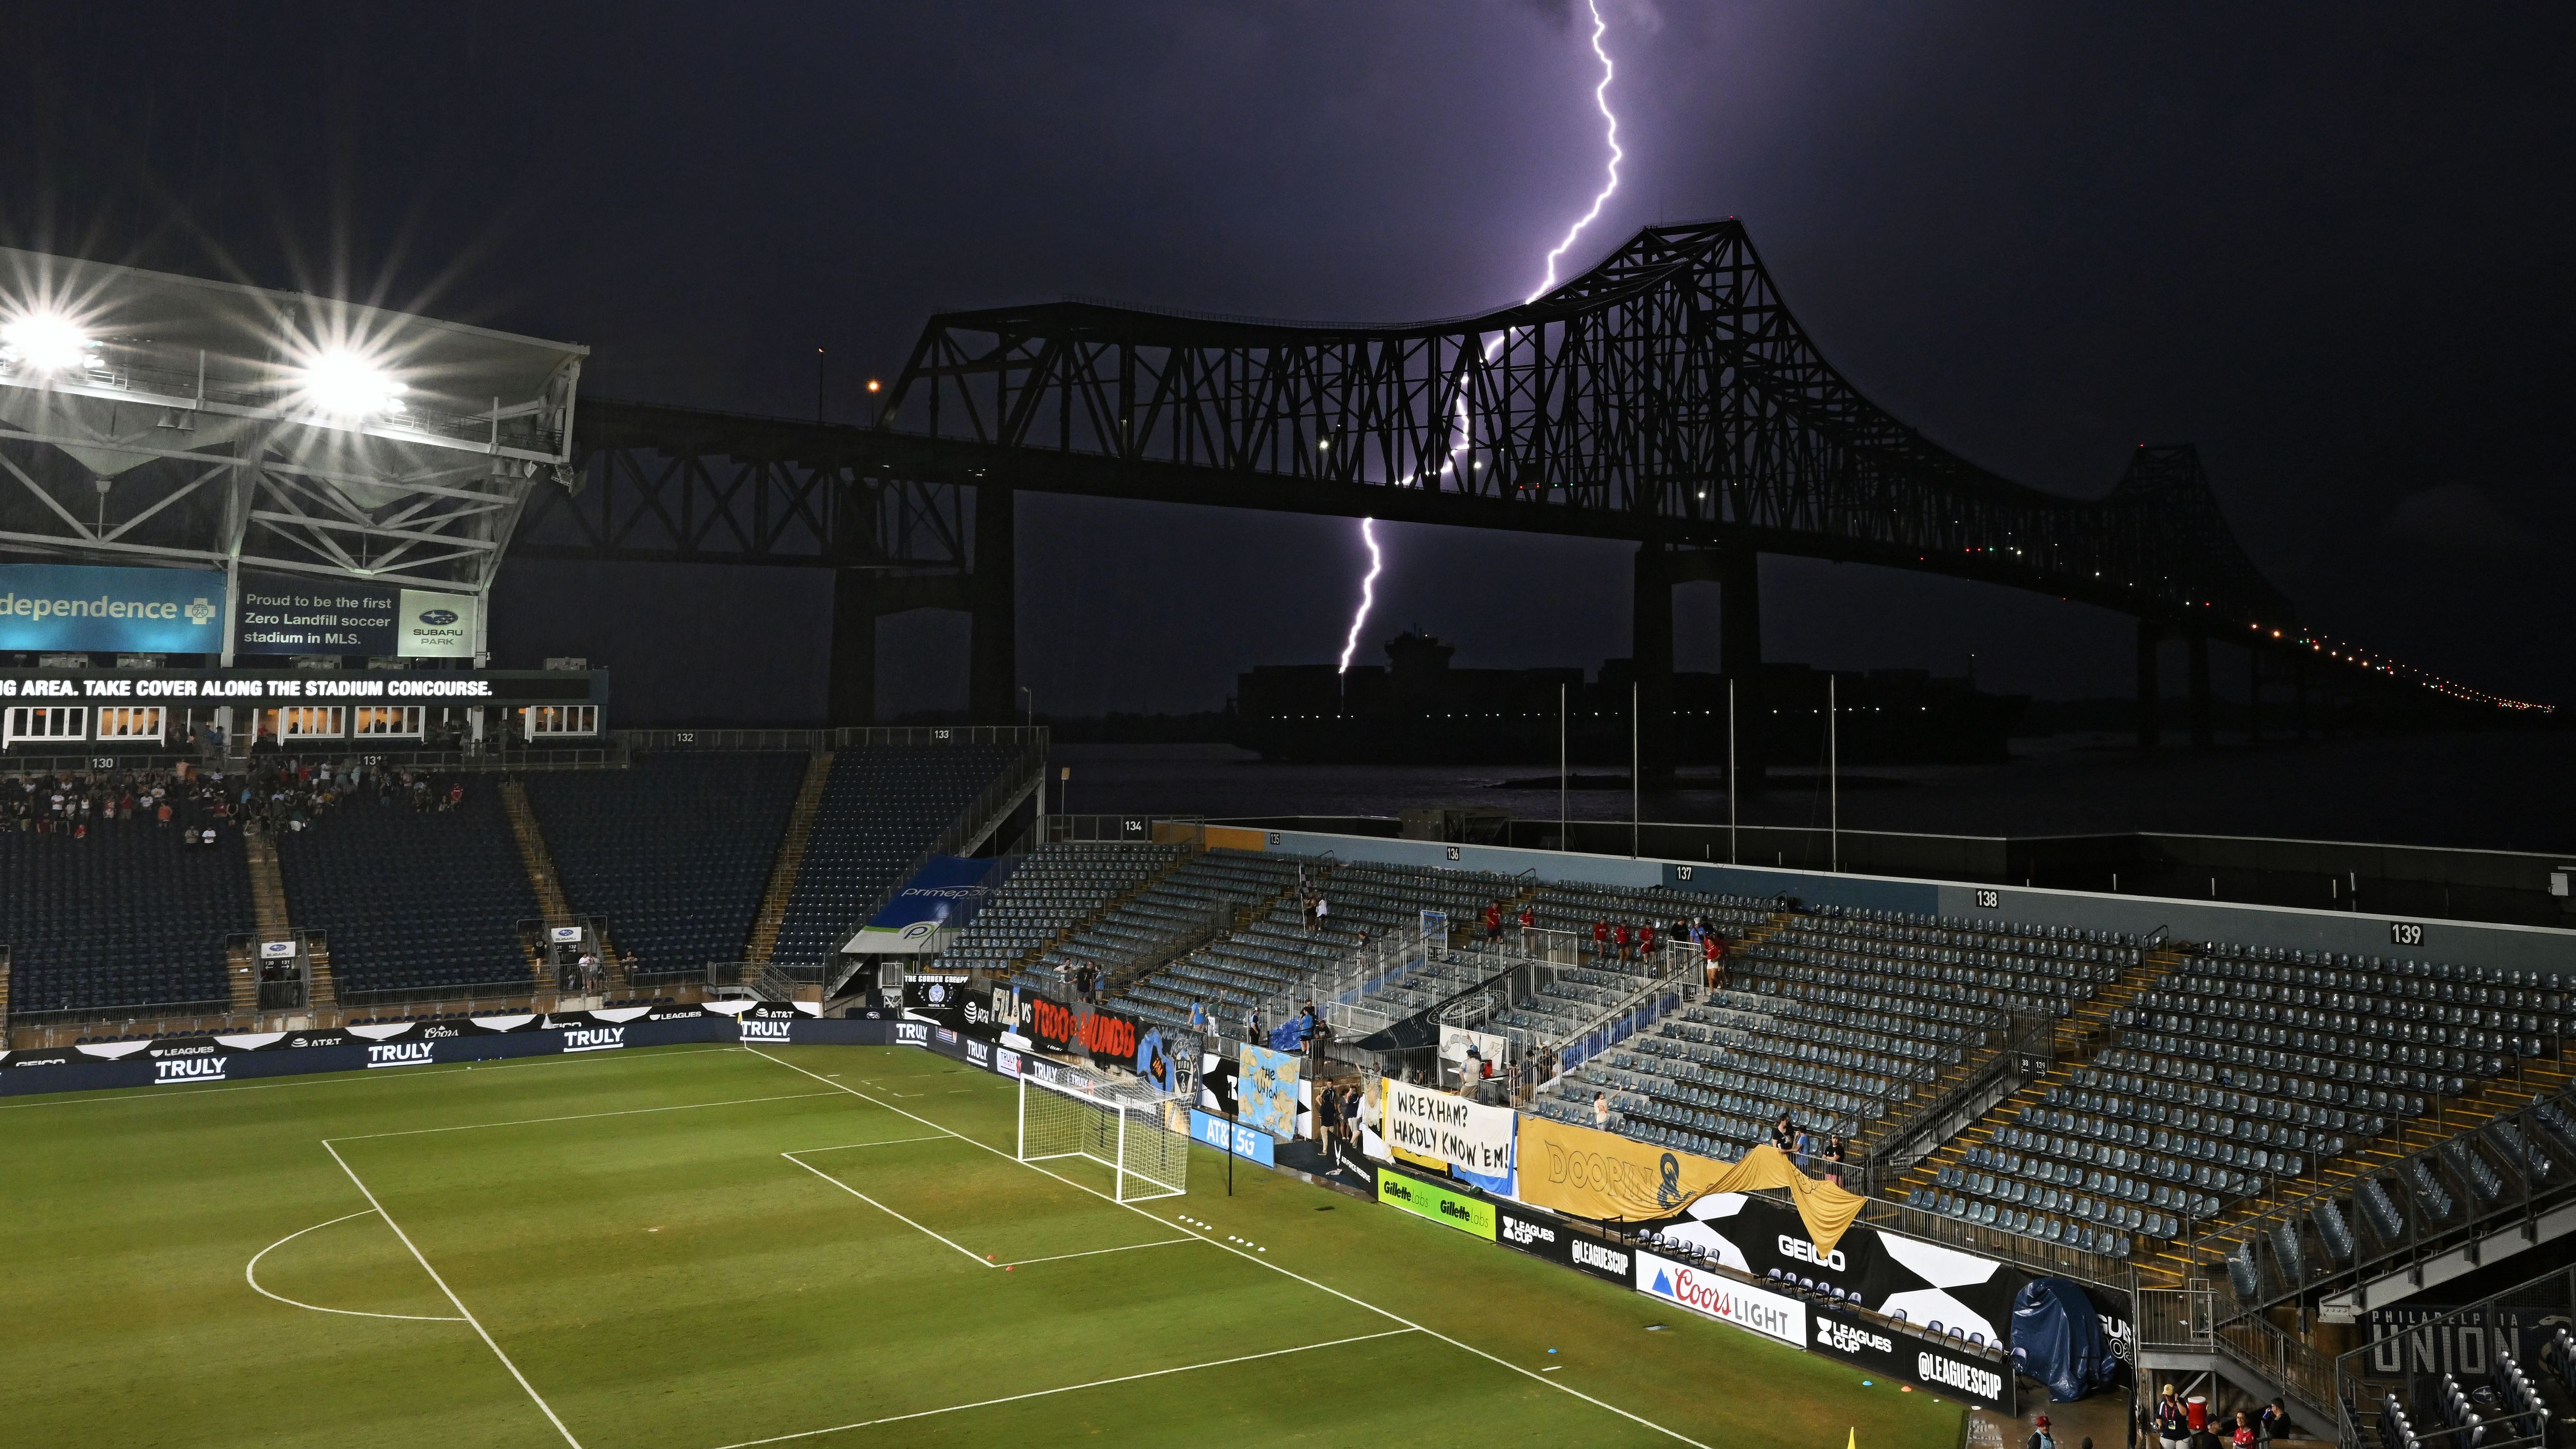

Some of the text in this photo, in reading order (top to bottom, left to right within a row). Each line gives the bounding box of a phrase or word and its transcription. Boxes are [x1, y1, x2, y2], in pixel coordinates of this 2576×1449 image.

[247, 593, 392, 609] Proud to be the first
[245, 613, 391, 627] Zero Landfill soccer
[244, 632, 361, 644] stadium in MLS.
[21, 680, 79, 696] AREA.
[83, 680, 131, 696] TAKE
[136, 680, 197, 696] COVER
[201, 680, 262, 696] ALONG
[267, 680, 301, 696] THE
[305, 680, 383, 696] STADIUM
[388, 680, 493, 696] CONCOURSE.
[677, 734, 693, 742] 132
[934, 730, 949, 739] 133
[92, 758, 113, 768] 130
[1125, 821, 1142, 831] 134
[1270, 834, 1280, 844] 135
[1448, 848, 1459, 860] 136
[1676, 866, 1692, 881] 137
[1977, 891, 1997, 906] 138
[2392, 925, 2421, 944] 139
[661, 1011, 702, 1020] LEAGUES
[1021, 1002, 1031, 1023] VS
[424, 1027, 459, 1039] Coors
[564, 1027, 625, 1046] TRULY
[740, 1021, 791, 1036] TRULY
[896, 1023, 928, 1040] TRULY
[311, 1038, 342, 1047] AT&T
[967, 1039, 988, 1060] TRULY
[165, 1046, 214, 1056] LEAGUES
[368, 1042, 434, 1061] TRULY
[1001, 1052, 1015, 1064] TRULY
[155, 1057, 227, 1077] TRULY
[1033, 1061, 1058, 1083] TRULY
[1071, 1074, 1088, 1088] TRULY
[1397, 1091, 1468, 1127] WREXHAM?
[1236, 1129, 1255, 1155] 5G
[1393, 1119, 1509, 1168] HARDLY KNOW 'EM!
[1514, 1219, 1555, 1243] LEAGUES
[1514, 1231, 1533, 1245] CUP
[1572, 1239, 1628, 1276] @LEAGUESCUP
[1675, 1268, 1788, 1335] Coors LIGHT
[1833, 1321, 1892, 1353] LEAGUES
[1833, 1335, 1860, 1353] CUP
[2373, 1324, 2520, 1373] UNION
[1918, 1351, 2002, 1401] @LEAGUESCUP
